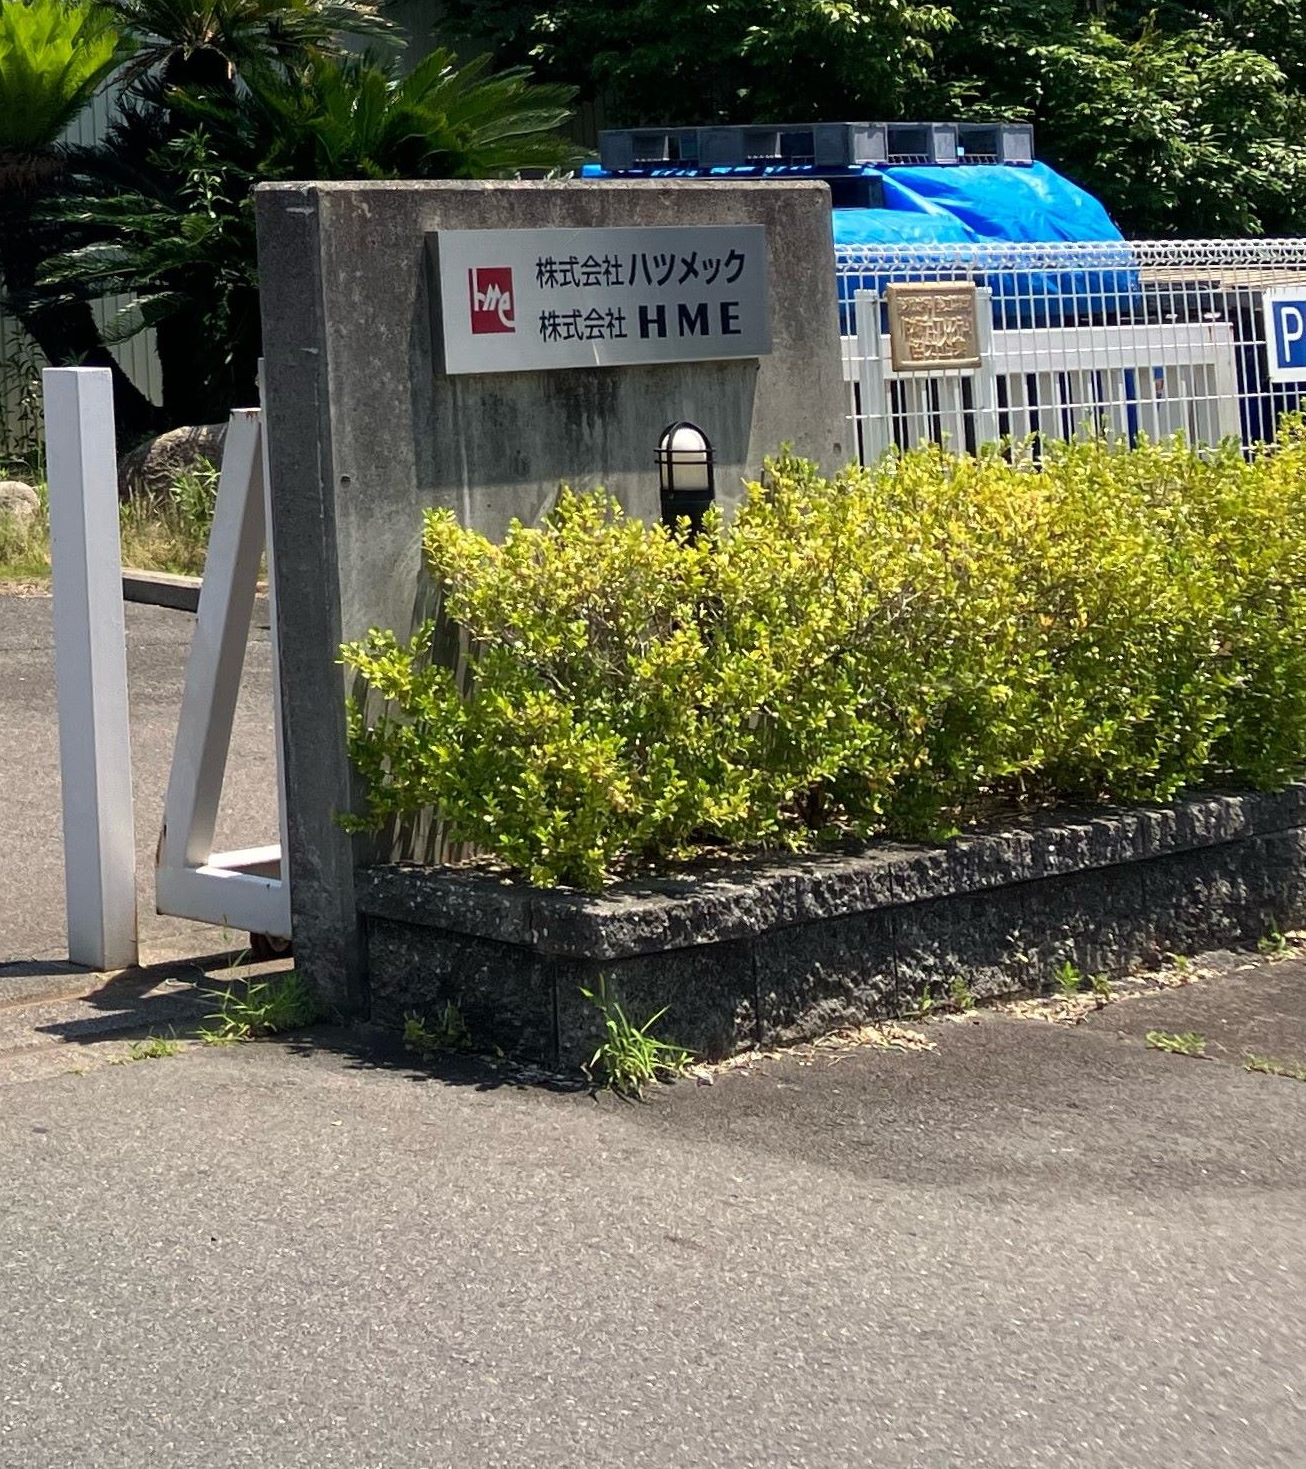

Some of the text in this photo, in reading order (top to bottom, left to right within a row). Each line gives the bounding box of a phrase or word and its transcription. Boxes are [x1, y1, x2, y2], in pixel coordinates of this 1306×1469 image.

[536, 249, 745, 289] 株式会社ハツメック
[539, 301, 742, 343] 株式会社 HME
[1281, 306, 1303, 362] P
